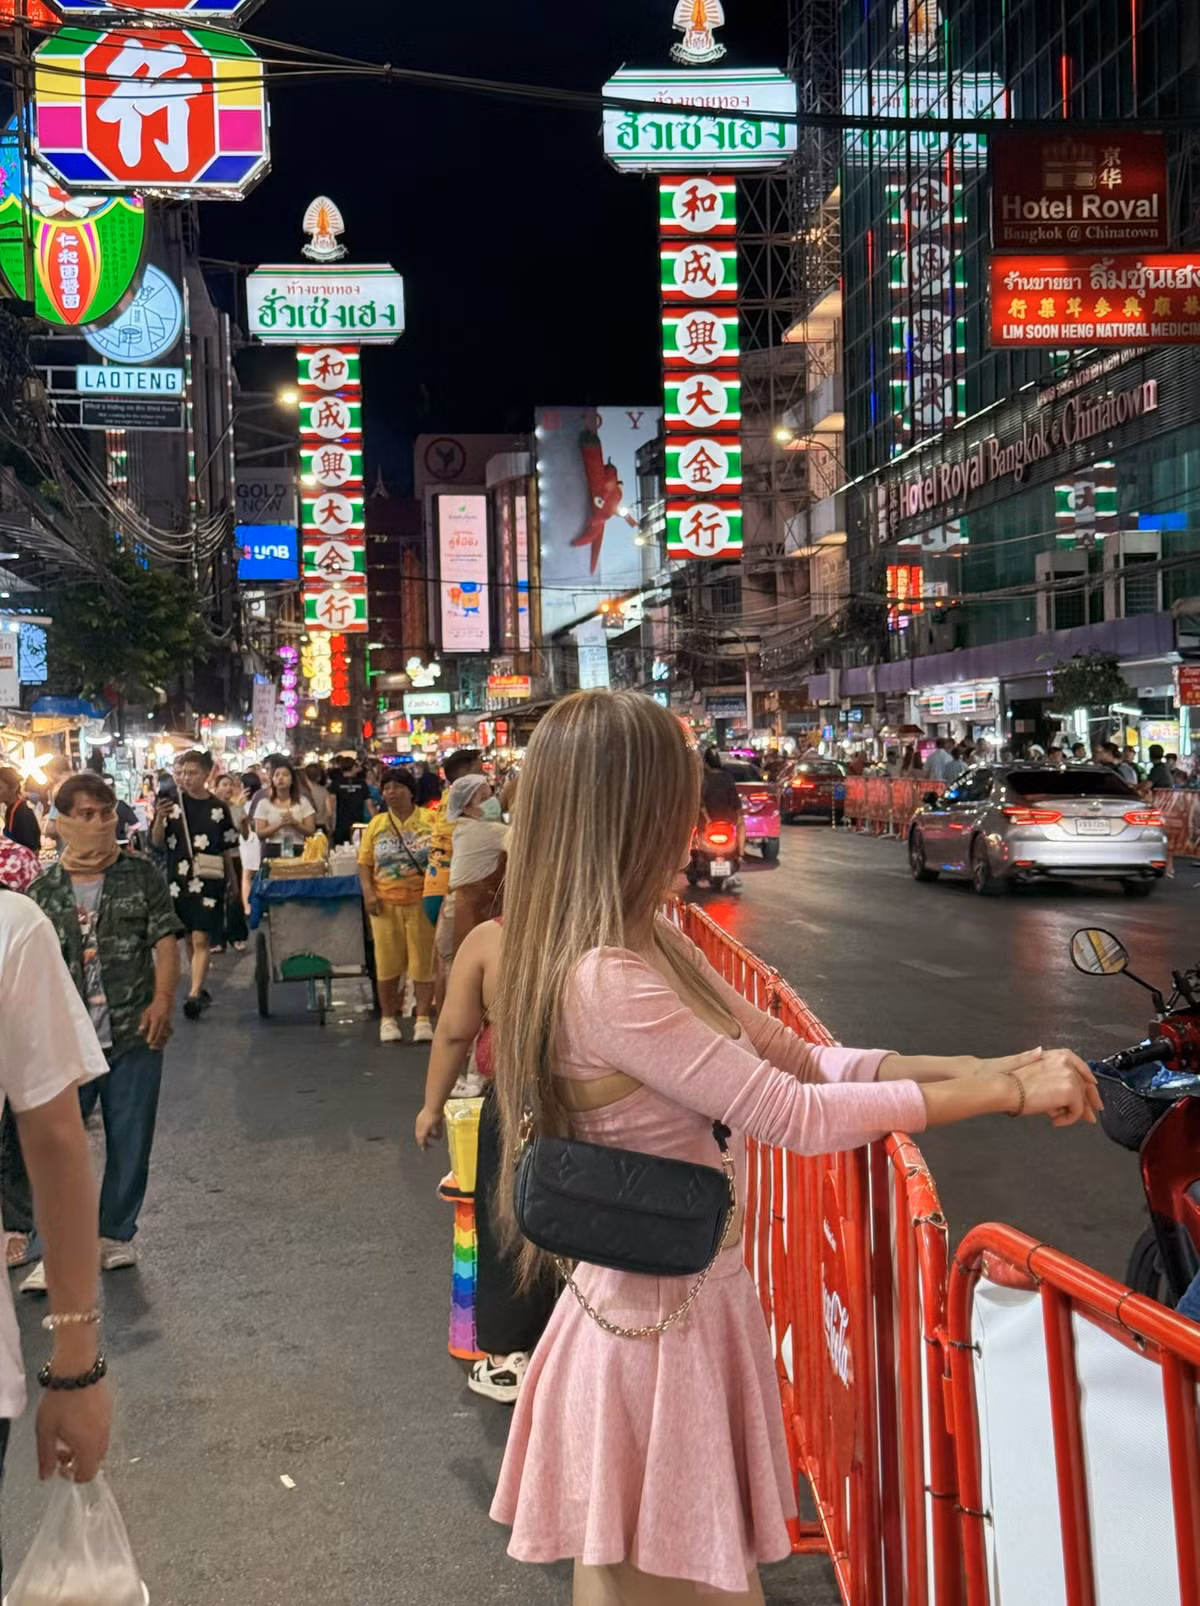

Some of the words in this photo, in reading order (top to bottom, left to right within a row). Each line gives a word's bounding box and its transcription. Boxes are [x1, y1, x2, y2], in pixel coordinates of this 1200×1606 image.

[1002, 195, 1072, 219] Hotel
[1082, 193, 1159, 220] Royal
[1003, 226, 1063, 244] Bangkok
[1066, 226, 1082, 242] @
[1085, 225, 1159, 240] Chinatown
[1003, 270, 1082, 291] ร้านขายยา
[258, 288, 396, 328] ฮั่วเซ่งเฮง
[1002, 324, 1024, 339] LIM
[1025, 323, 1059, 339] SOON
[1061, 323, 1094, 338] HENG
[1095, 322, 1150, 338] NATURAL
[85, 371, 176, 390] LAOTENG
[900, 467, 938, 520] Hotel
[940, 443, 985, 503] Royal
[989, 412, 1052, 482] Bangkok
[1062, 380, 1158, 445] Chinatown
[236, 483, 287, 498] GOLD
[243, 500, 282, 512] NOW
